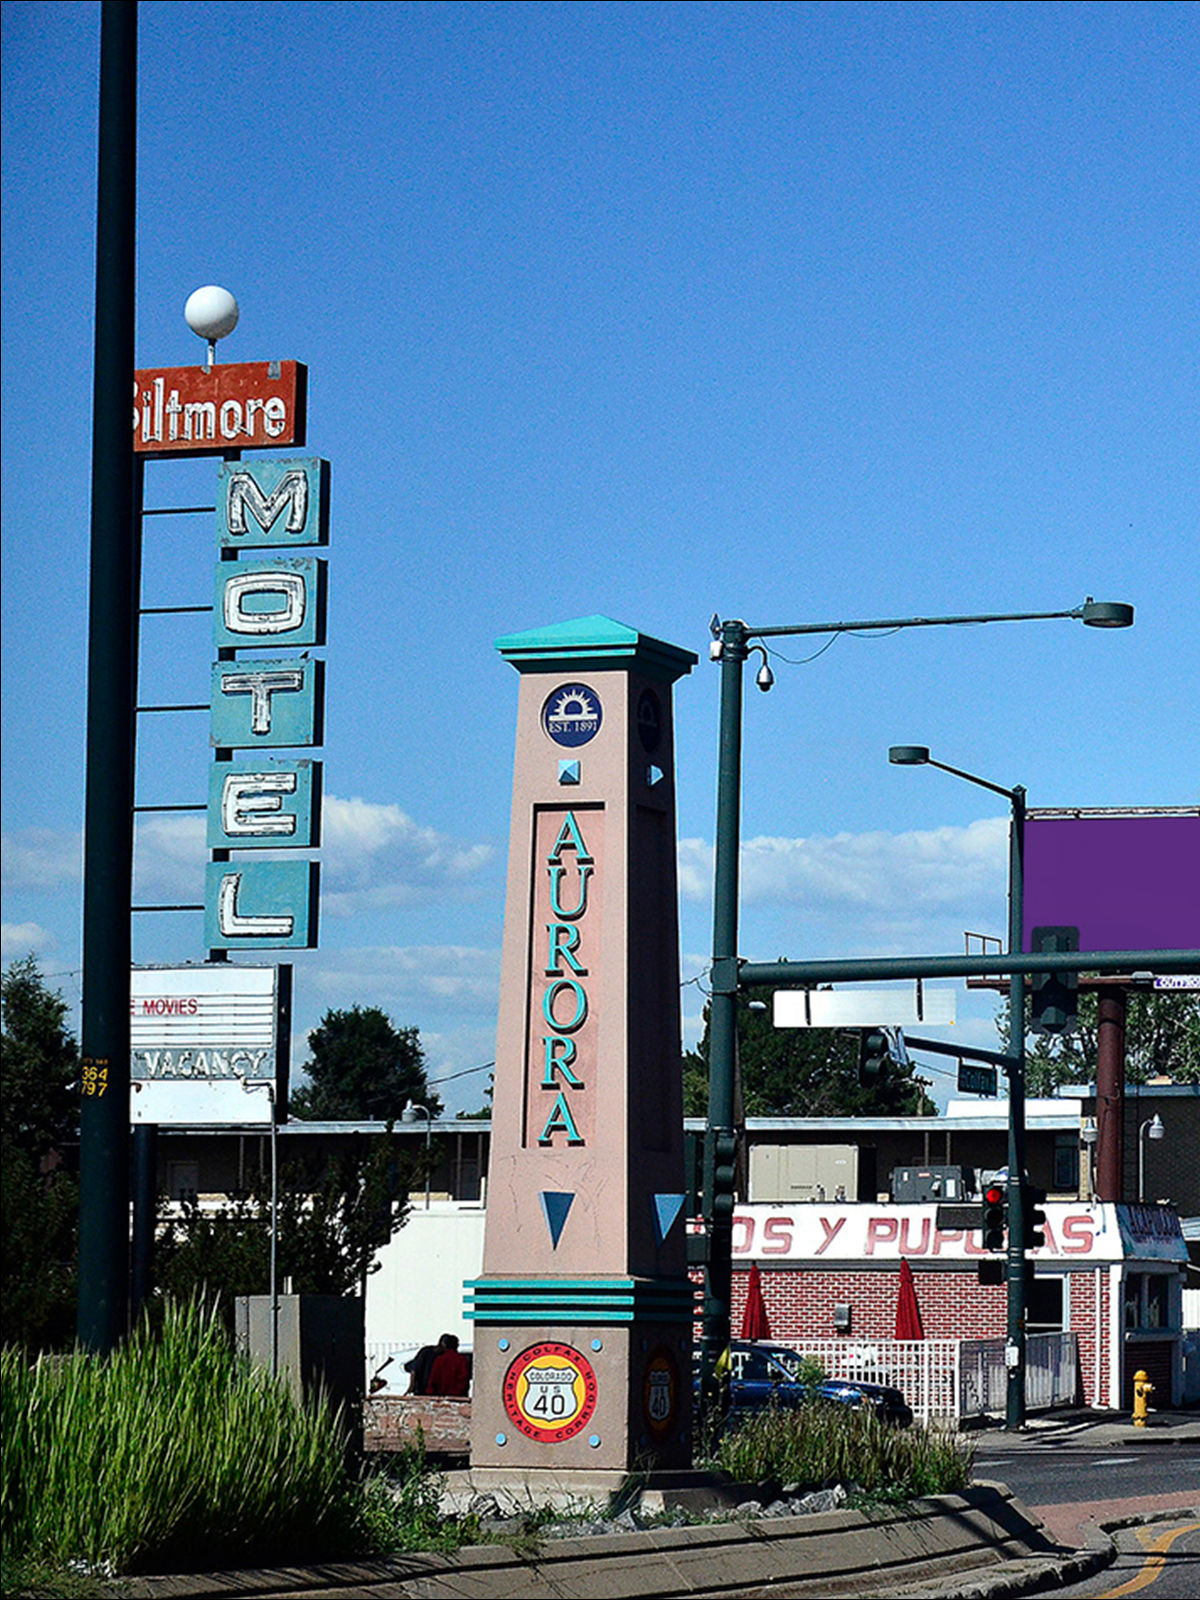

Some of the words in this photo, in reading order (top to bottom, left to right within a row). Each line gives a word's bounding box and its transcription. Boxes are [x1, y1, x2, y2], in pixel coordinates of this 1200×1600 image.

[219, 469, 309, 938] MOTEL
[549, 721, 572, 734] EST.
[575, 719, 597, 732] 1891
[537, 810, 594, 1147] AURORA
[143, 998, 198, 1015] MOVIES
[82, 1065, 109, 1081] 364
[144, 1051, 268, 1078] VACANCY
[814, 1216, 848, 1255] Y
[522, 1346, 581, 1362] COLFAX
[529, 1371, 573, 1382] COLORADO
[506, 1371, 541, 1438] HERITAGE
[533, 1394, 565, 1416] 40
